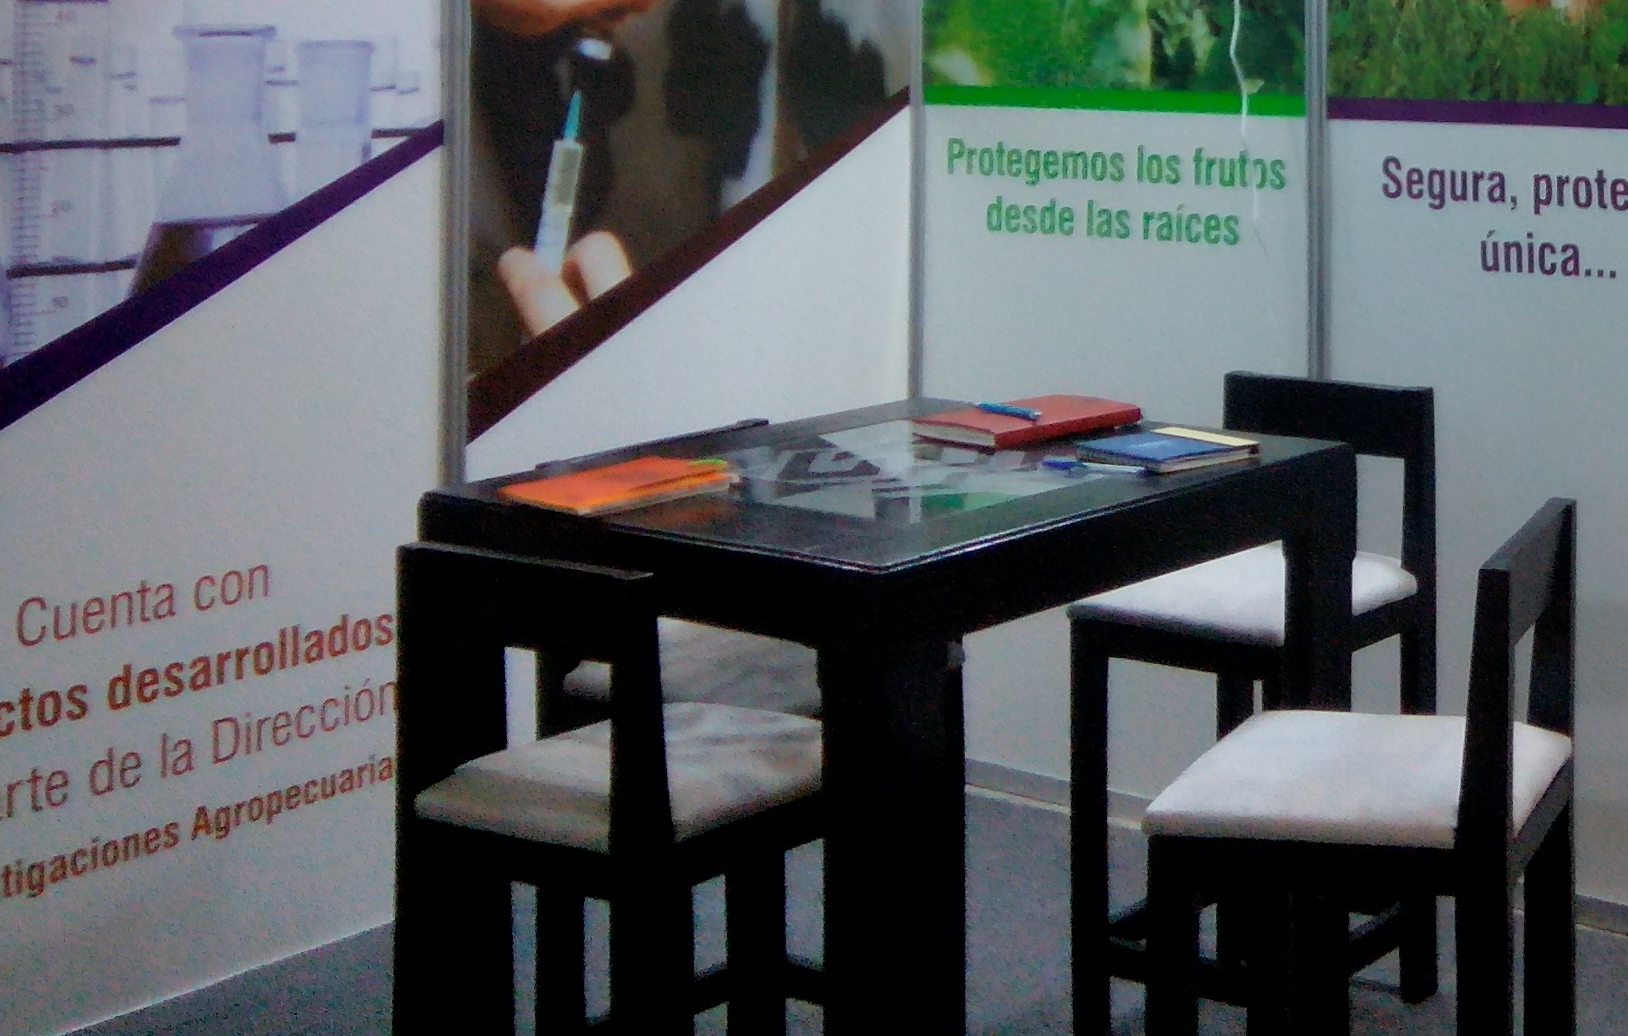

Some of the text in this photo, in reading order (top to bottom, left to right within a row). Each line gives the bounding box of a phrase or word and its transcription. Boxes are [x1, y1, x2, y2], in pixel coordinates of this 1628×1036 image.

[947, 138, 1287, 190] Protegemos los frutos
[1382, 156, 1518, 211] Segura,
[986, 195, 1240, 246] desde las raíces
[1480, 230, 1617, 279] única...
[16, 563, 270, 647] Cuenta con
[0, 613, 394, 737] ctos desarrollados
[0, 678, 398, 821] rte de la Dirección
[2, 754, 394, 898] tigaciones Agropecuaria
